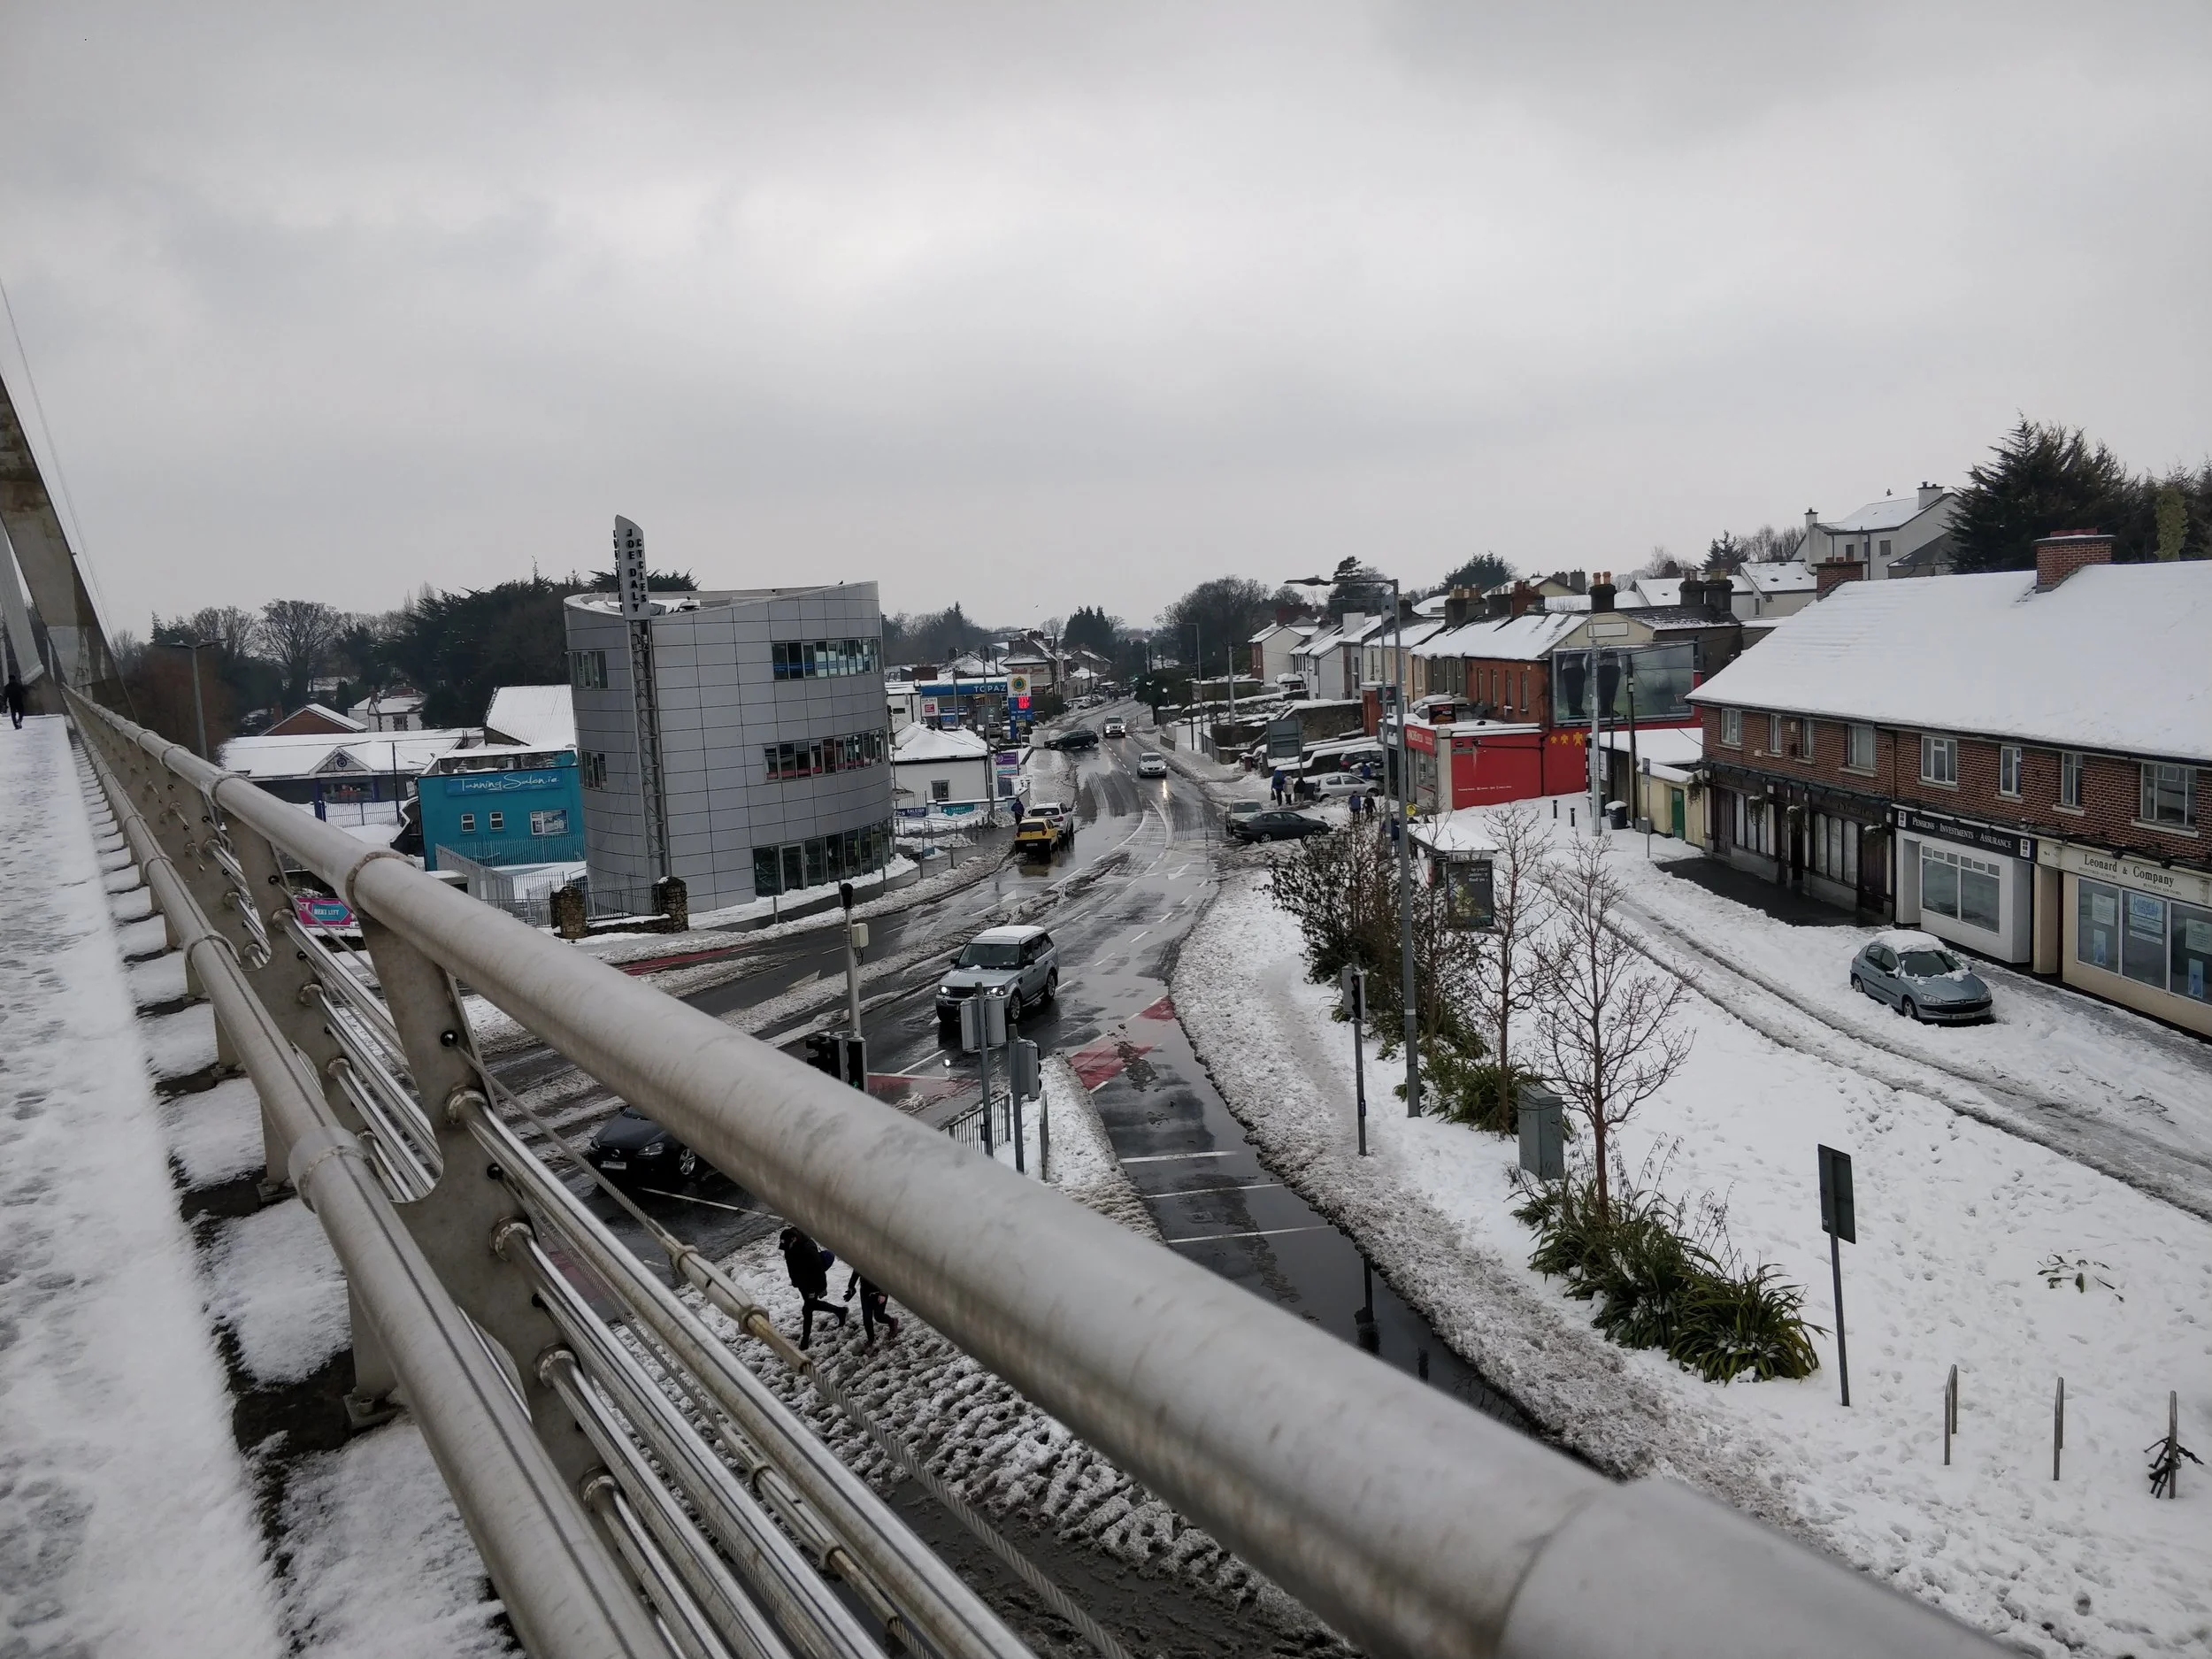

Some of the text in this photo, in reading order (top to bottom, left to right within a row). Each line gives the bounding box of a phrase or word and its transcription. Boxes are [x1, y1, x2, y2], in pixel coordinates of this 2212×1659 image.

[626, 528, 639, 612] JOE DALY
[636, 538, 647, 603] CYCLES
[973, 684, 1007, 694] TOPAZ
[1912, 817, 2012, 849] PENSIONS INVESTMENTS ASSURANCE
[2084, 854, 2175, 887] Leonard & Company
